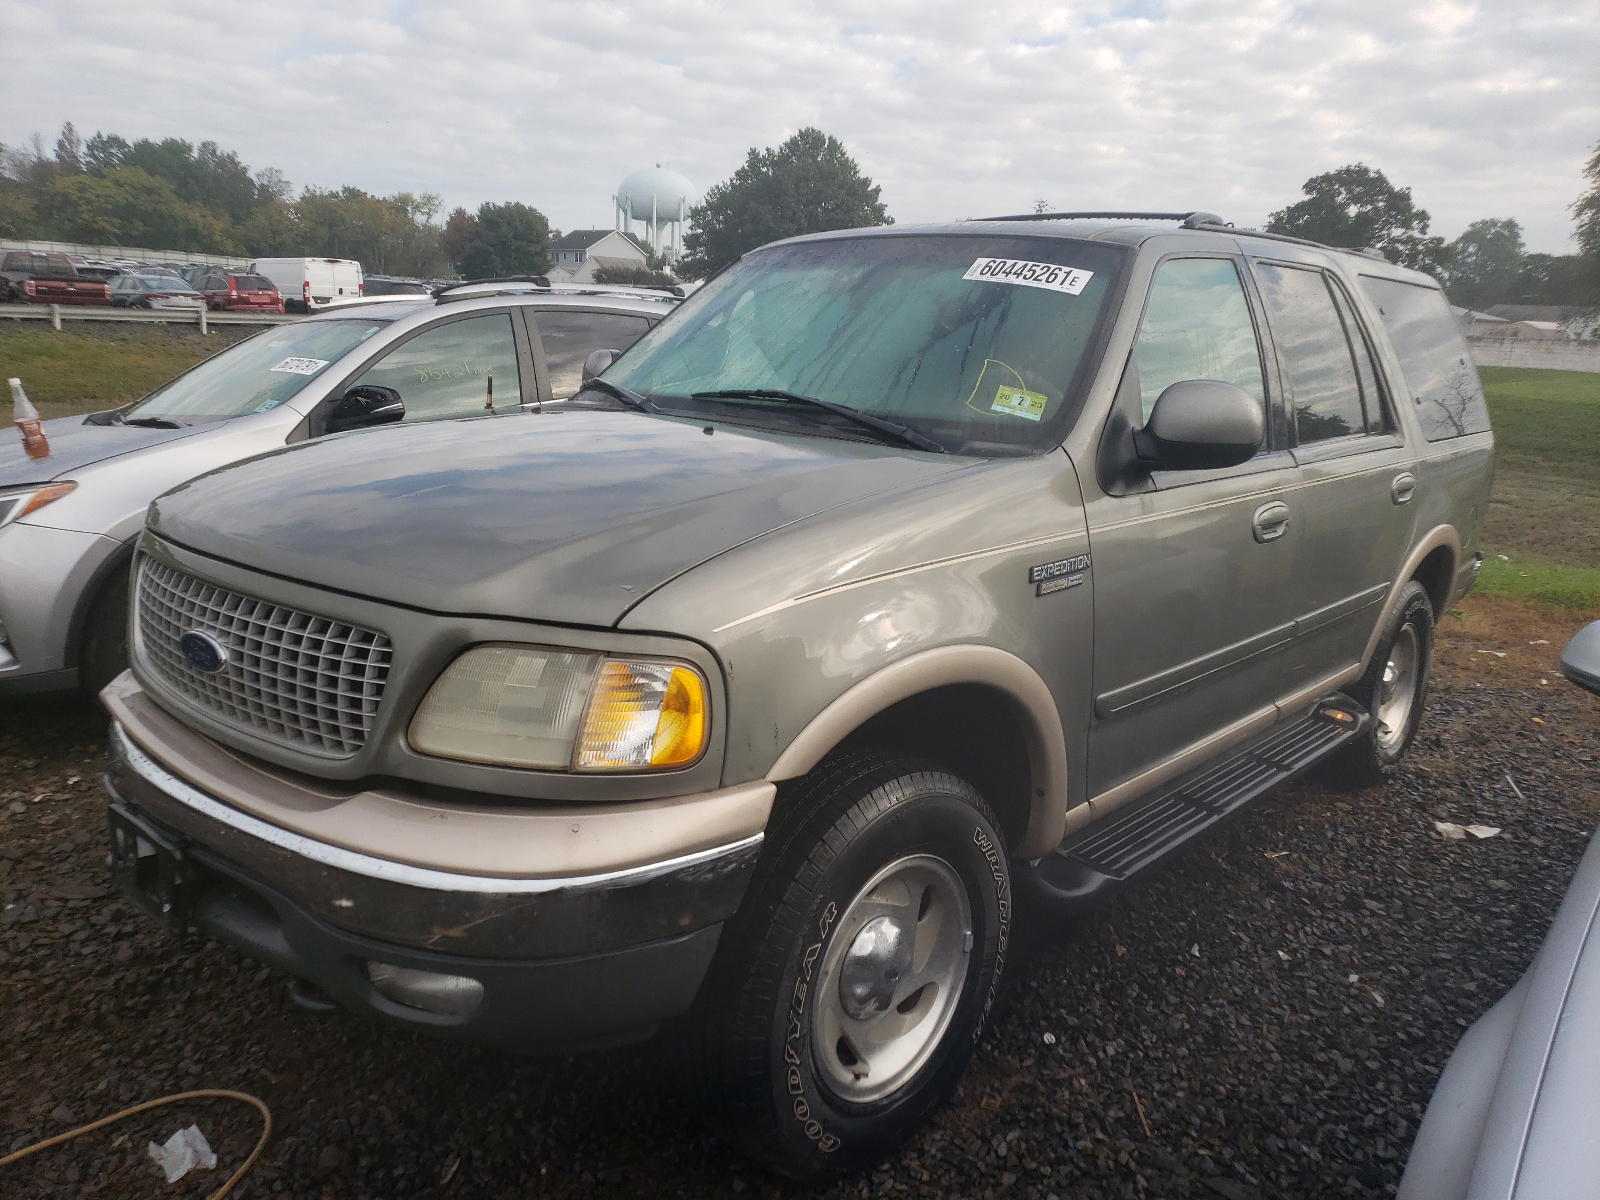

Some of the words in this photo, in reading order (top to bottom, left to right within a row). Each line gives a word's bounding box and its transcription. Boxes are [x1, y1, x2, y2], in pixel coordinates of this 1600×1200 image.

[980, 260, 1073, 286] 60445261
[1018, 395, 1025, 406] 7
[1030, 400, 1042, 409] 23
[1033, 553, 1091, 581] EXPEDITION
[785, 902, 841, 1152] GOODYEAR
